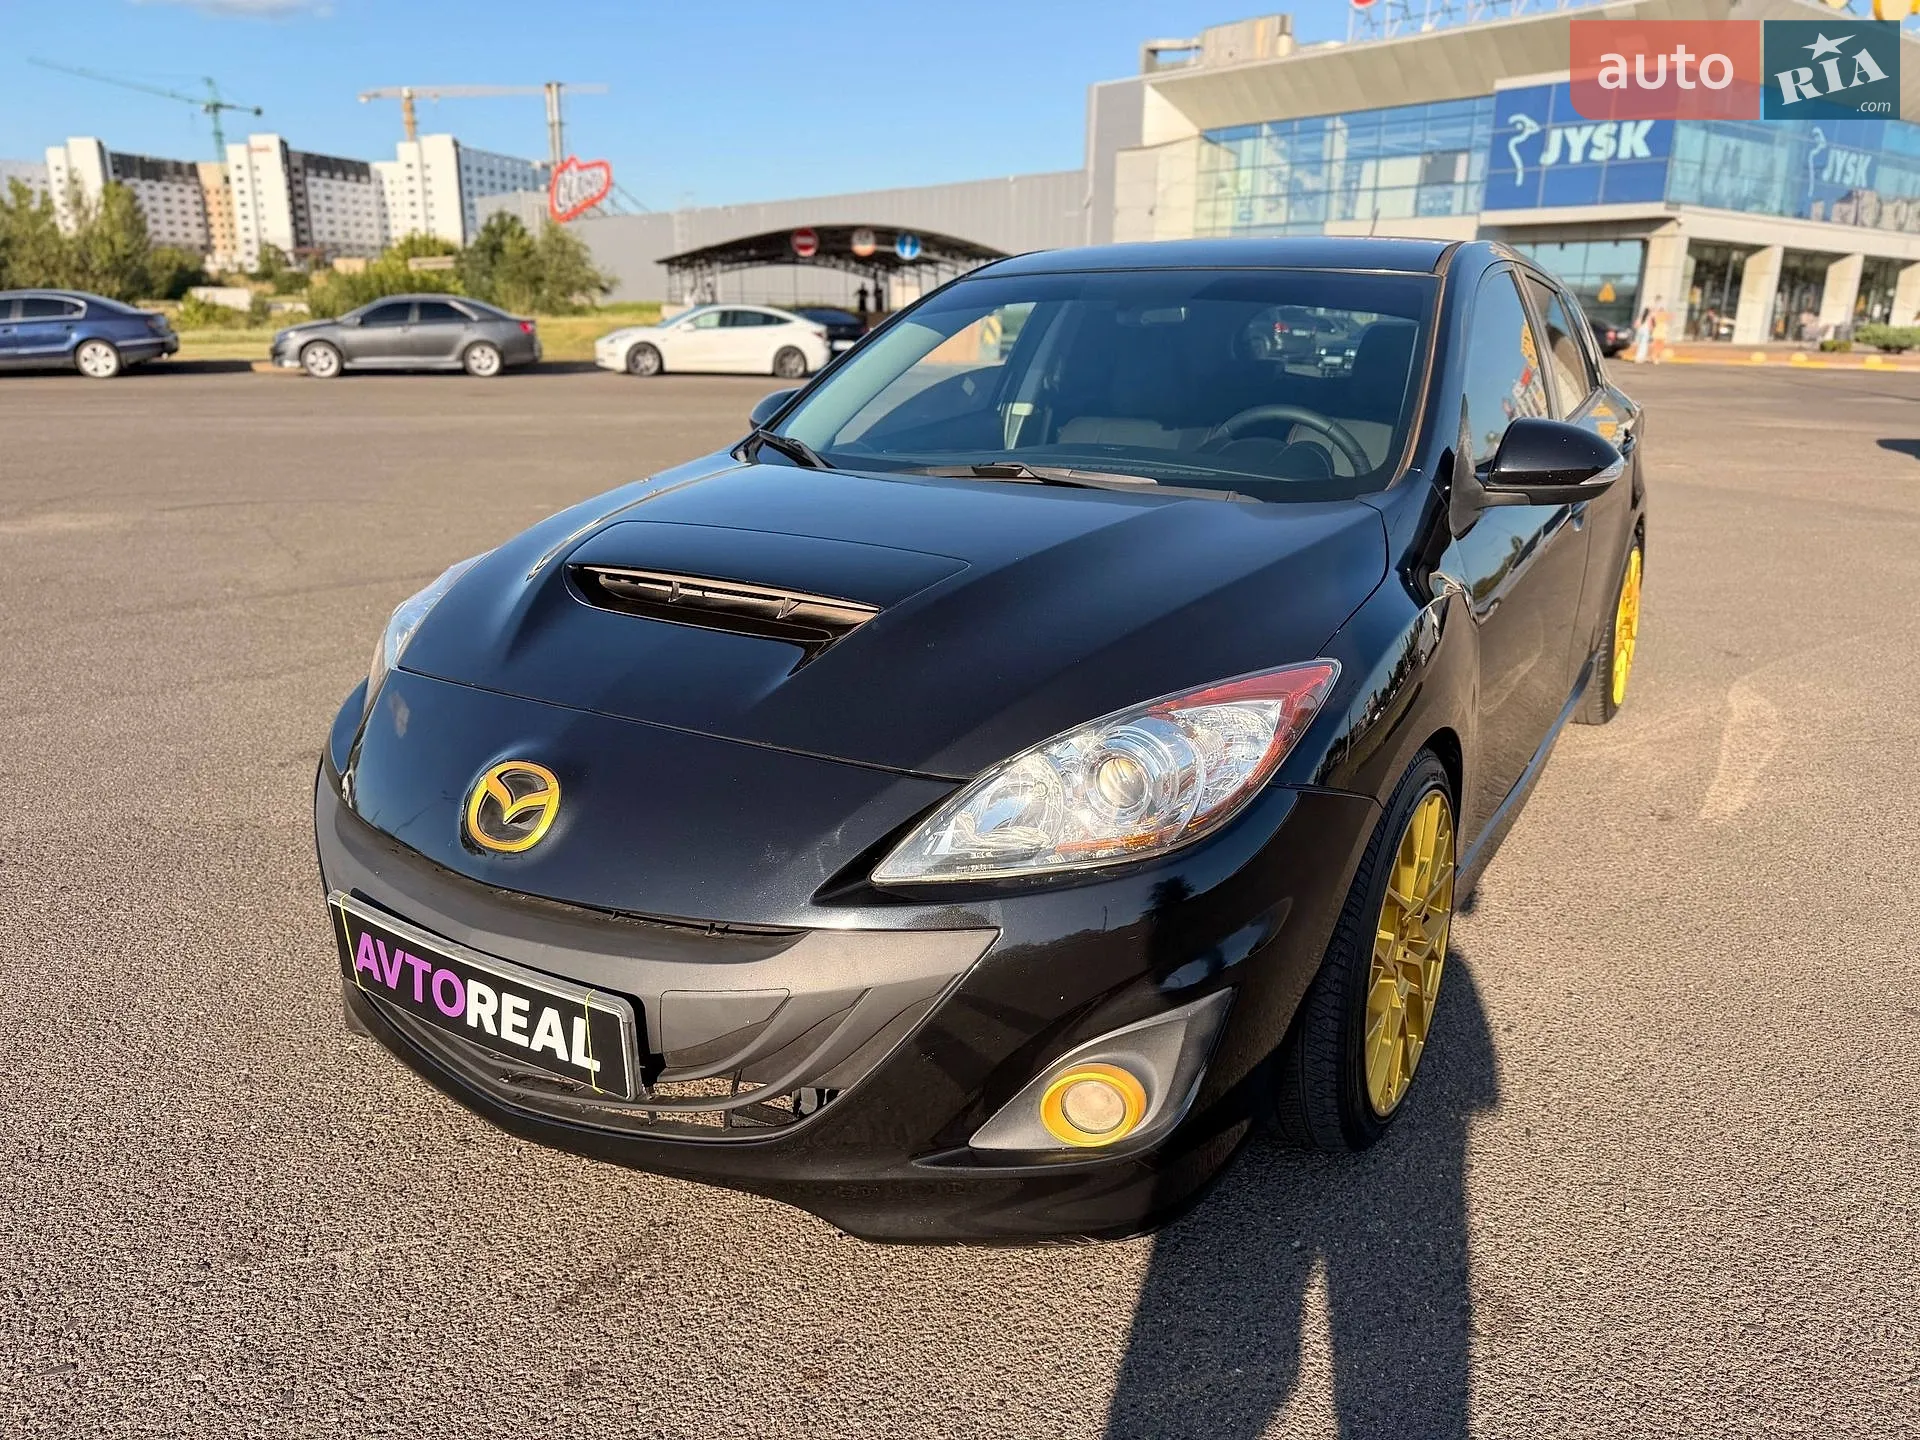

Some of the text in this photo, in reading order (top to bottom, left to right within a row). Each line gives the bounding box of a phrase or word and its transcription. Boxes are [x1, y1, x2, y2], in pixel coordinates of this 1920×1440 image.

[1540, 119, 1655, 165] JYSK
[1822, 148, 1872, 188] JYSK
[356, 932, 601, 1073] AVTOREAL
